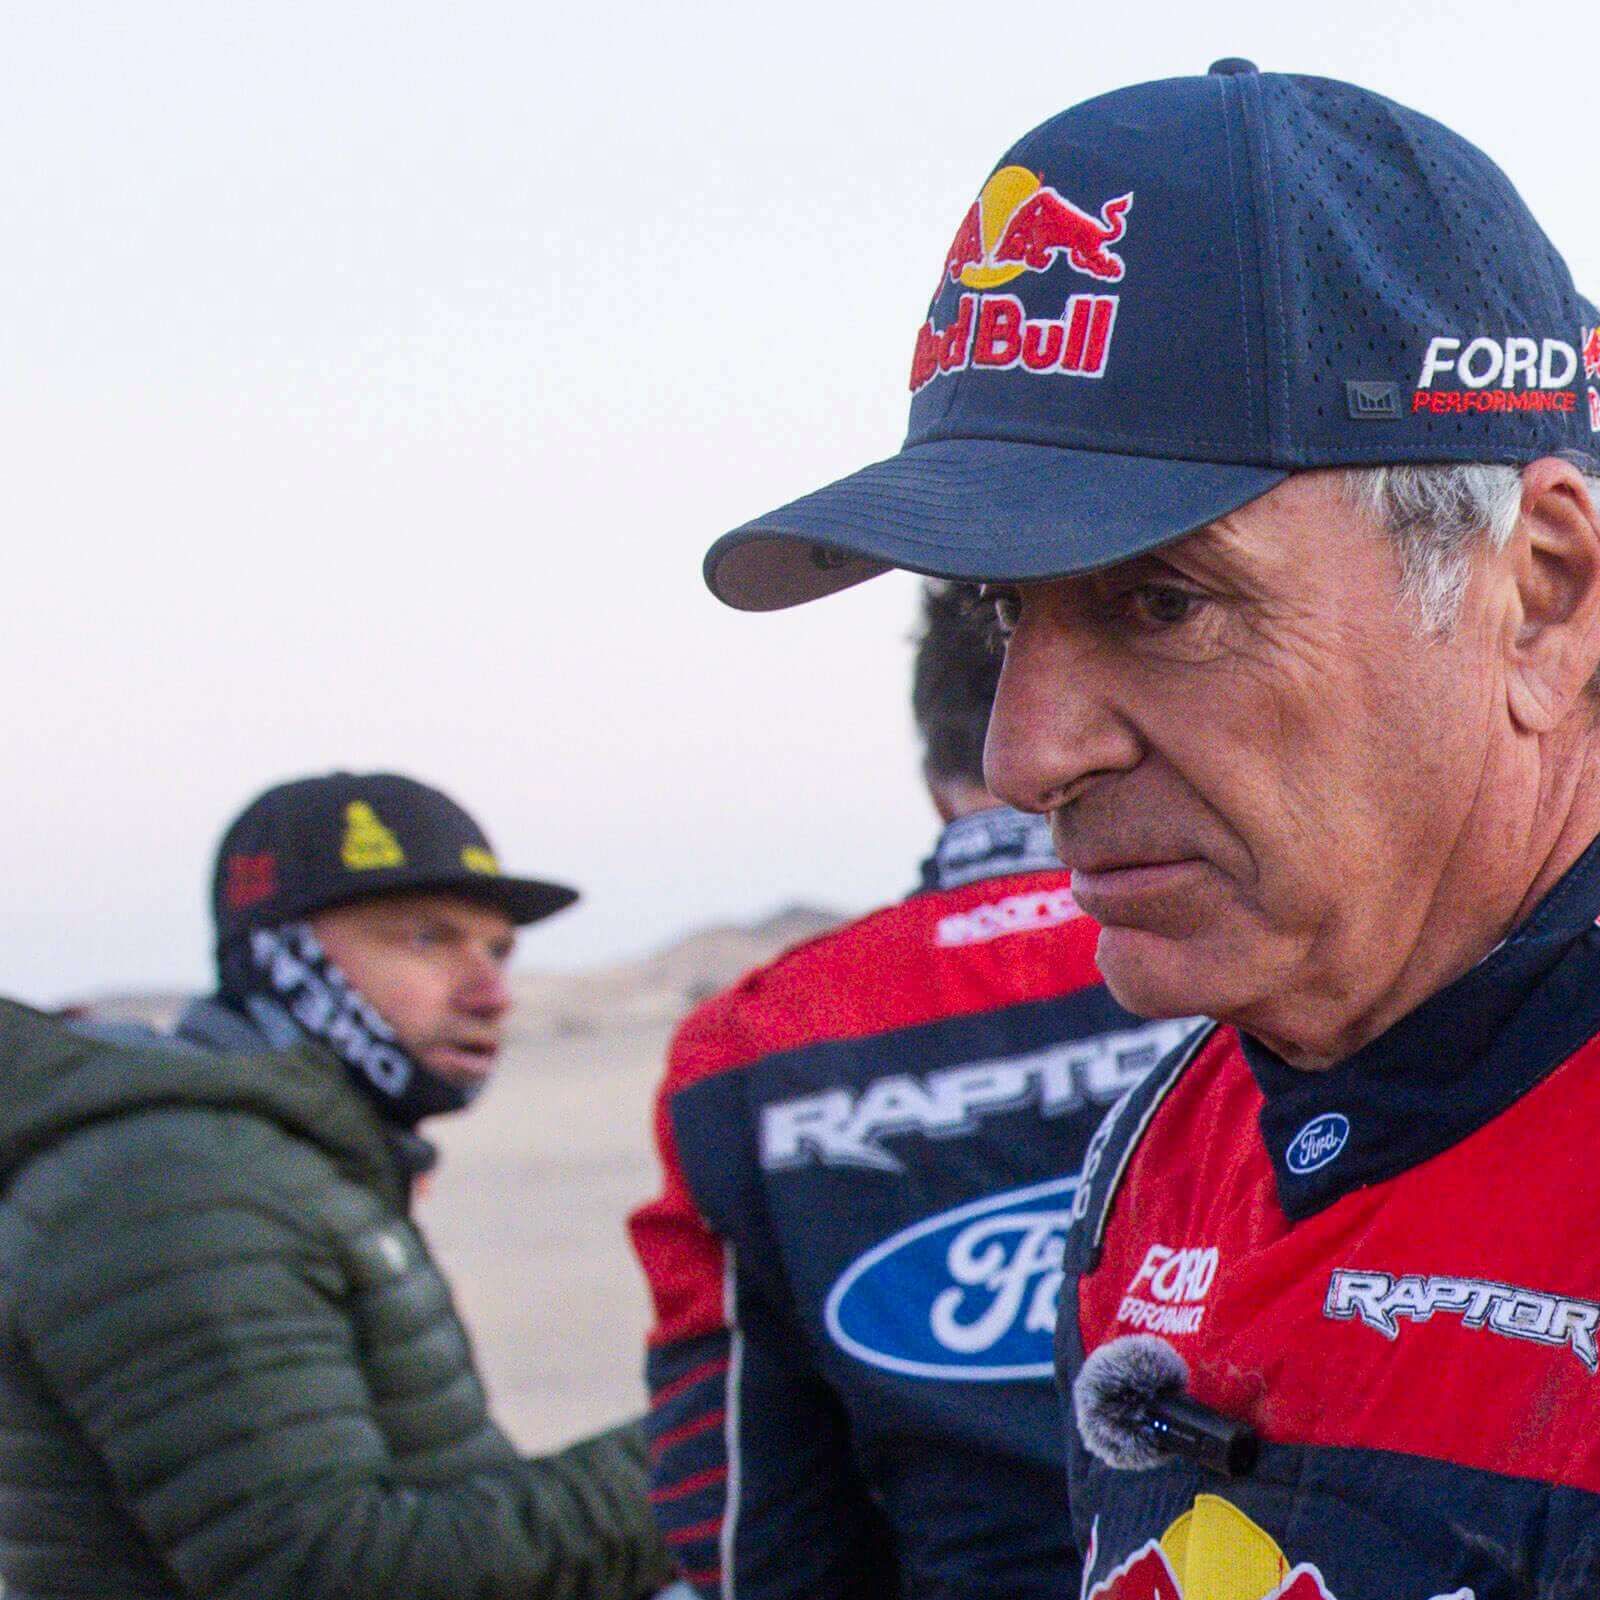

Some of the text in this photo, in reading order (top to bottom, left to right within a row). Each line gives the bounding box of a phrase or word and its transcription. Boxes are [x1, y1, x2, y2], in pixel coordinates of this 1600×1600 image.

[971, 294, 1120, 378] Bull
[1417, 336, 1578, 389] FORD
[1410, 389, 1579, 415] PERFORMANCE
[1297, 1120, 1344, 1167] Ford
